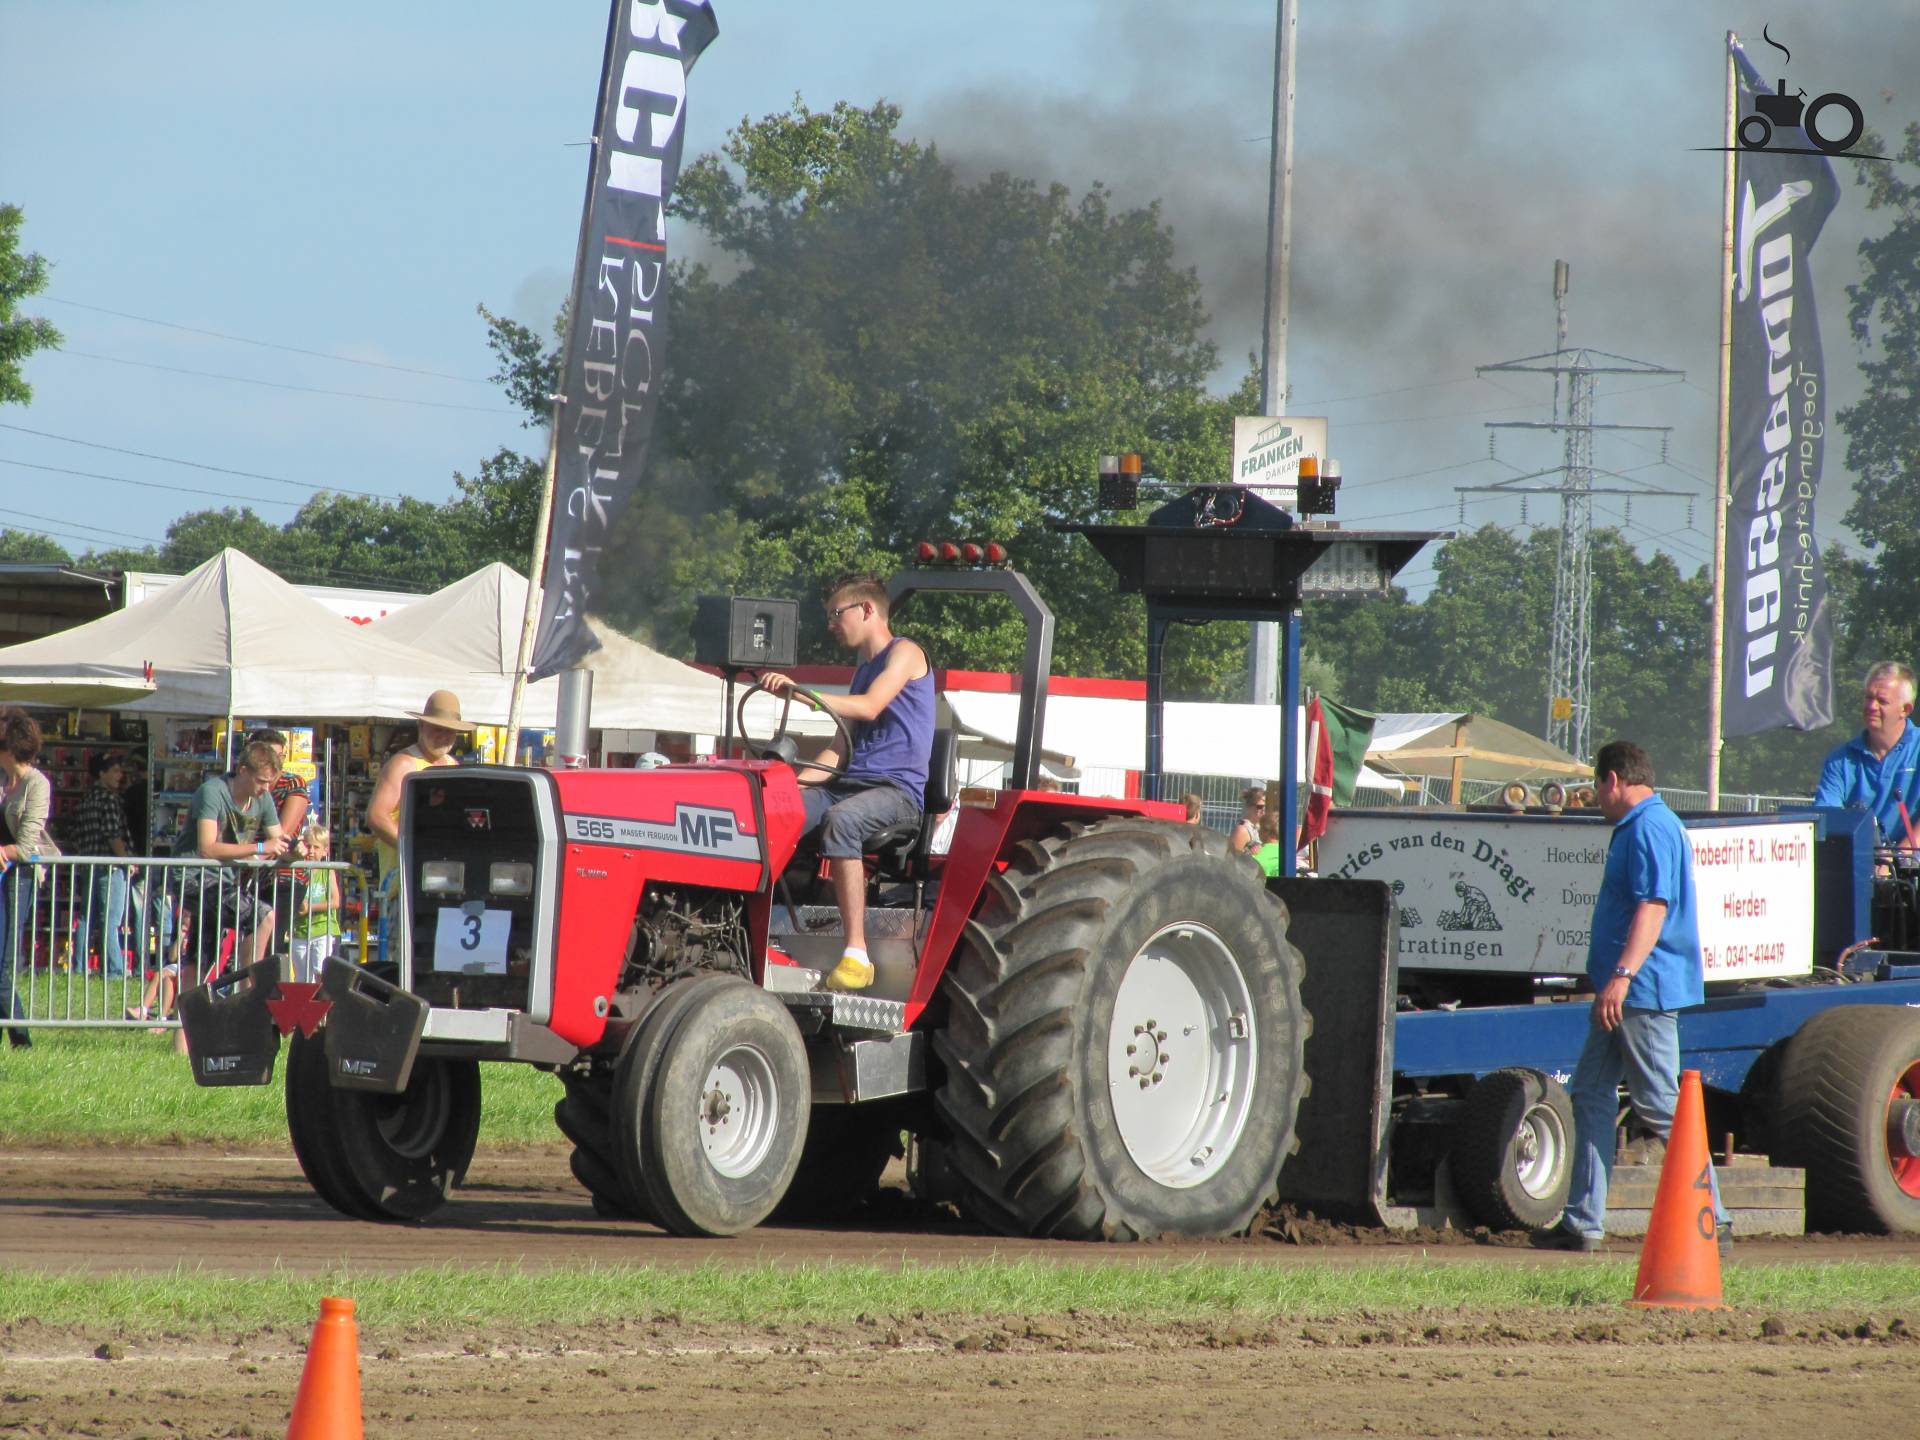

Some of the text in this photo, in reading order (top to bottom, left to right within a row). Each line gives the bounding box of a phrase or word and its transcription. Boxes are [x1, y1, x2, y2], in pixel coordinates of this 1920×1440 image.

[1241, 435, 1303, 478] FRANKEN
[576, 819, 678, 842] 565 MASSEY FERGUSON
[680, 812, 733, 848] MF
[1389, 835, 1424, 852] van
[1431, 831, 1465, 853] den
[1472, 838, 1536, 904] Dragt
[1724, 891, 1767, 918] Hierden
[459, 914, 482, 951] 3
[1399, 937, 1503, 960] tratingen
[205, 1056, 241, 1073] MF
[341, 1060, 377, 1075] MF
